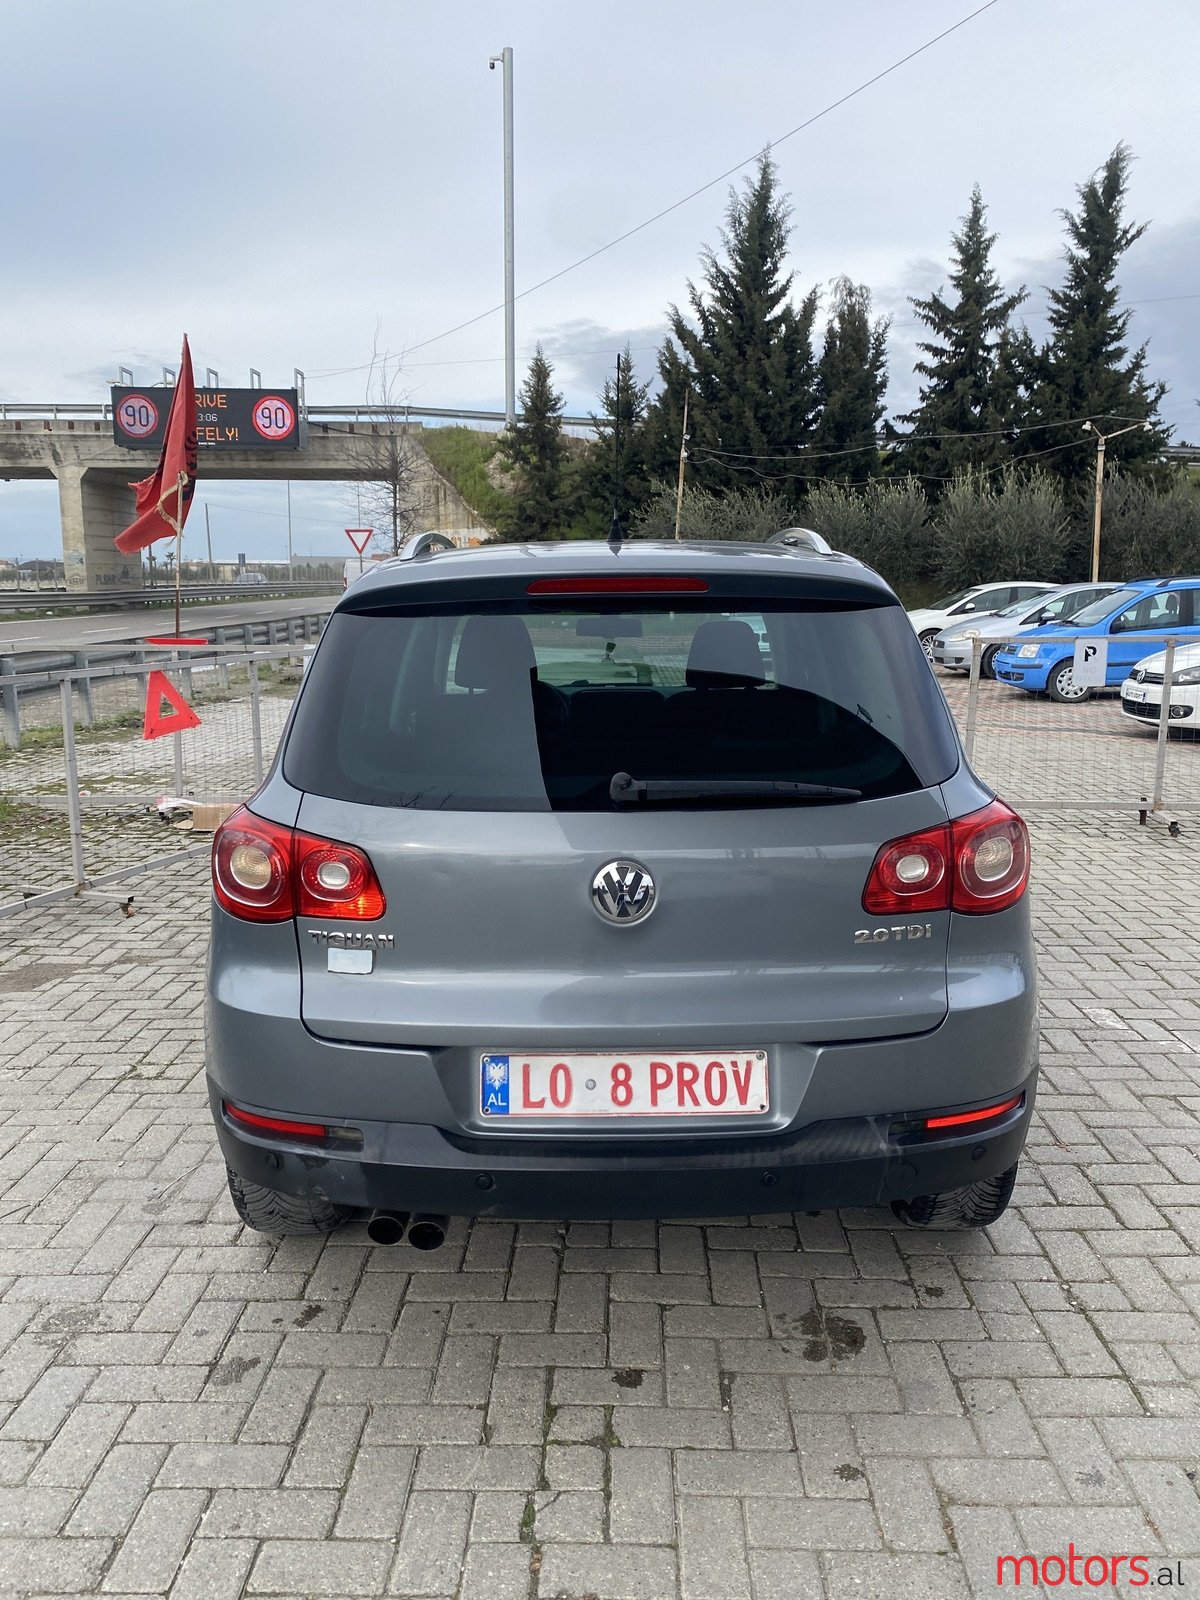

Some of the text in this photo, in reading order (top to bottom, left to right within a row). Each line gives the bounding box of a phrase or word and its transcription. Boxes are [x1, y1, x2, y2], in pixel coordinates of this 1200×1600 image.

[195, 394, 227, 408] RIVE
[125, 405, 150, 427] 90
[261, 407, 285, 429] 90
[196, 427, 239, 441] FELY!
[1084, 645, 1097, 662] P
[307, 929, 396, 950] TIGUAN
[610, 1063, 633, 1107] 8
[650, 1060, 753, 1107] PROV
[487, 1093, 507, 1106] AL
